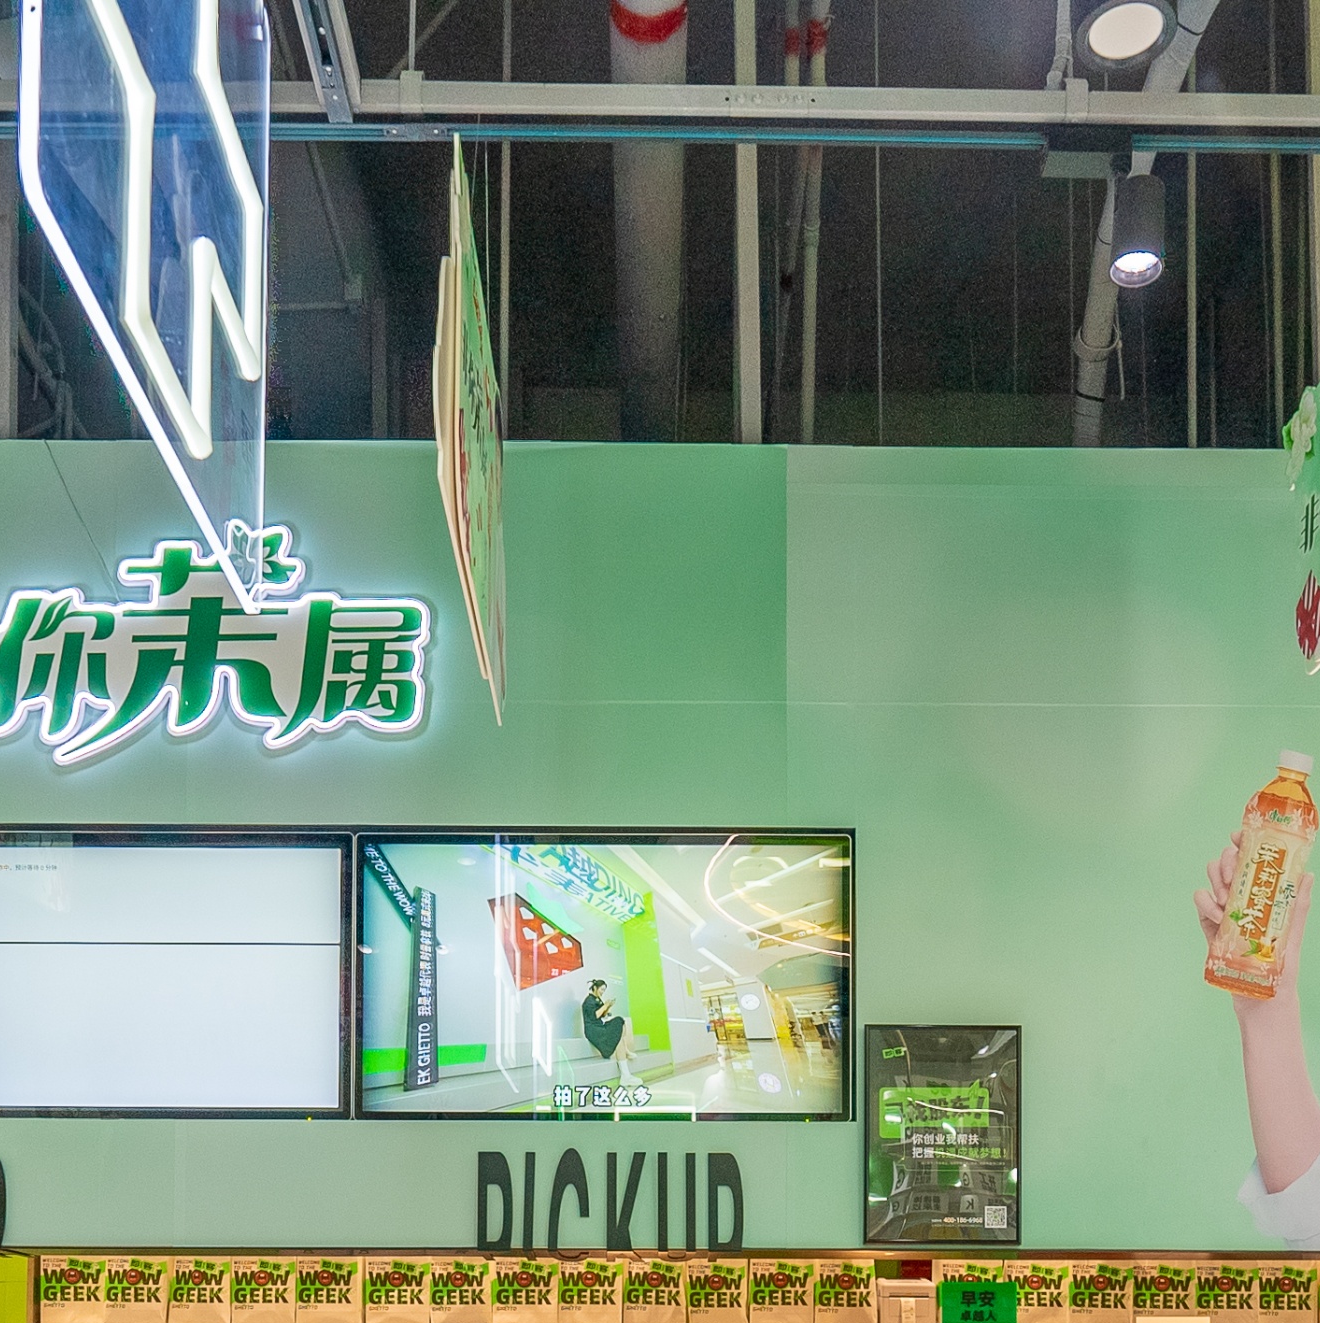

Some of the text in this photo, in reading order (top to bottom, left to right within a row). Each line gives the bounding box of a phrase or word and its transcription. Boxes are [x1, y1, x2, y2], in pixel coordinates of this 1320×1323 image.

[417, 1022, 431, 1066] GHETTO
[552, 1085, 653, 1108] 拍了这么多
[43, 1286, 101, 1302] GEEK
[561, 1288, 617, 1306] GEEK
[960, 1290, 995, 1308] 早安
